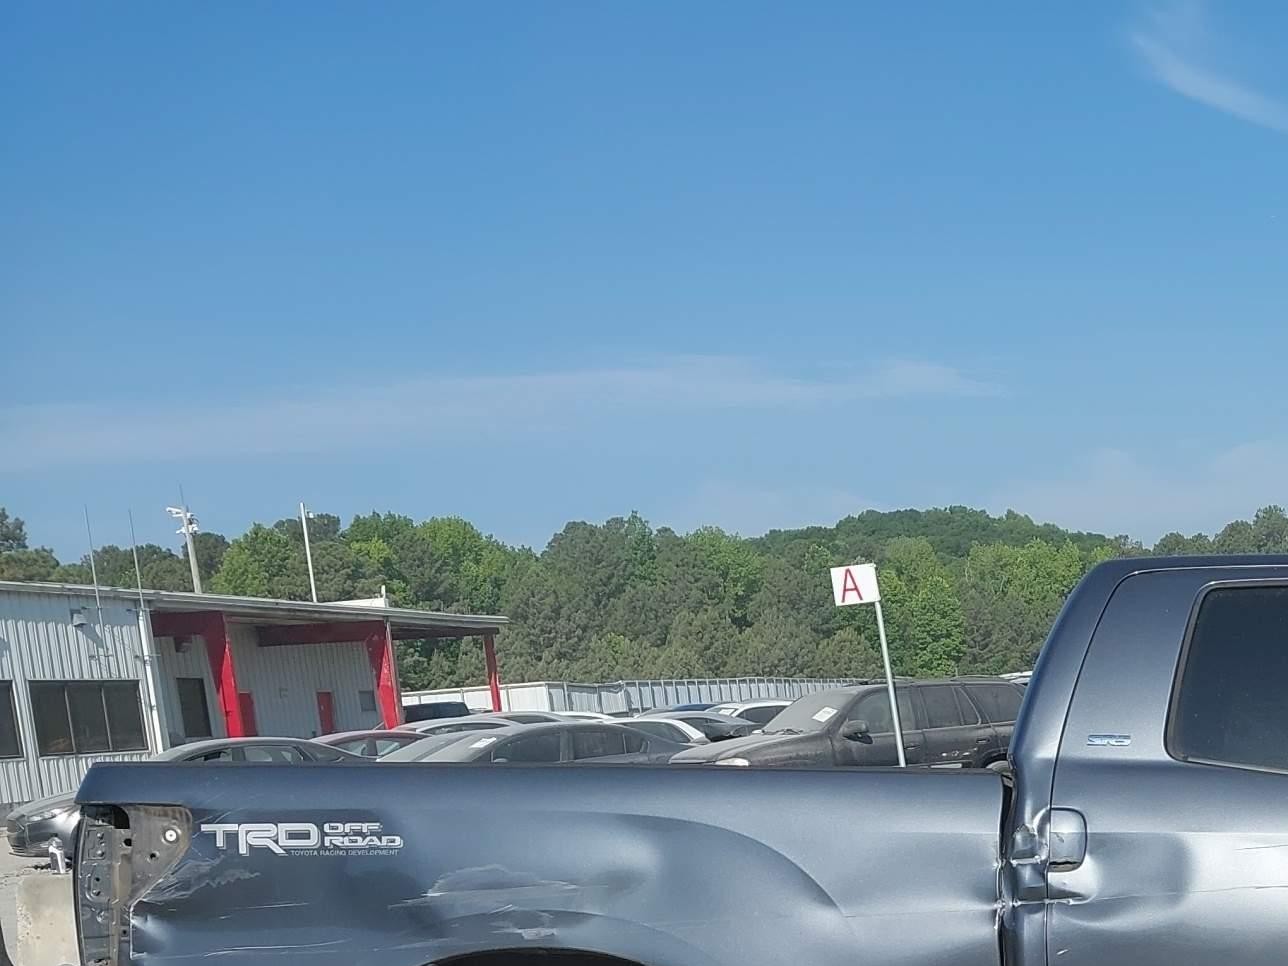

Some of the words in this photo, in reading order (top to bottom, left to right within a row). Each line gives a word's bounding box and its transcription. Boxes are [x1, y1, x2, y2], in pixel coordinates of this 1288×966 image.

[841, 568, 863, 603] A
[323, 823, 382, 834] OFF
[201, 823, 320, 856] TRD
[324, 836, 404, 848] ROAD
[291, 849, 318, 857] TOYOTA
